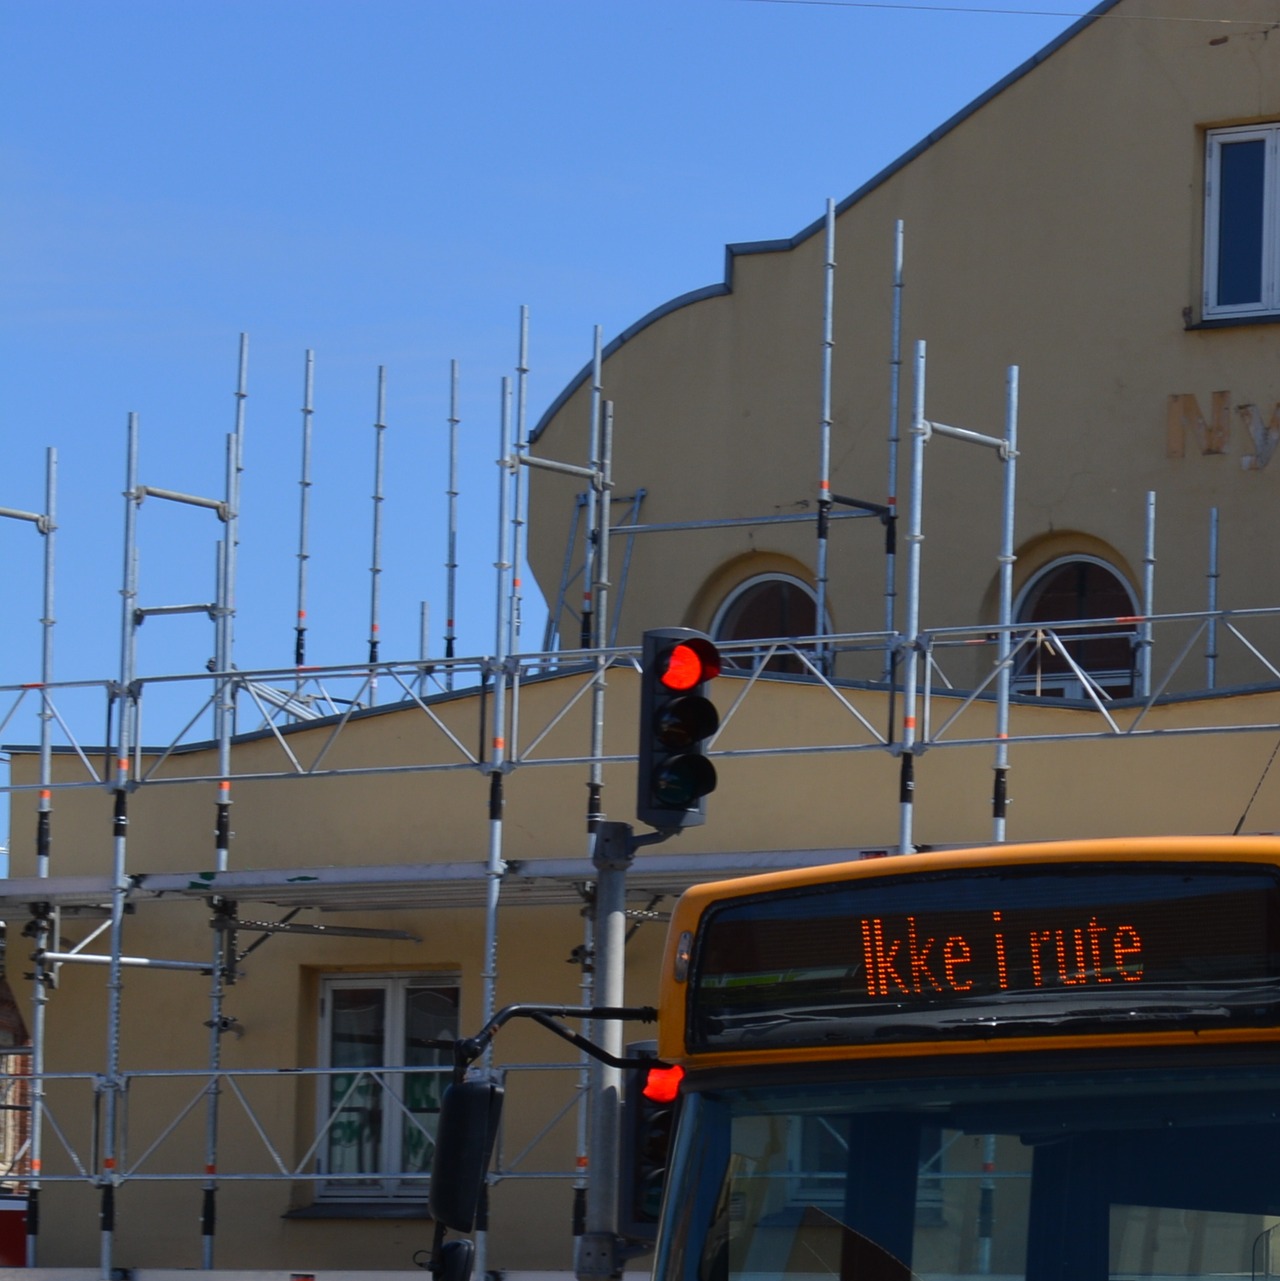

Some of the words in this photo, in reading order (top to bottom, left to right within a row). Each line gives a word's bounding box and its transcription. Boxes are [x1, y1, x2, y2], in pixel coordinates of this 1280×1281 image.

[860, 915, 972, 996] Ikke
[993, 910, 1008, 989] i
[1030, 915, 1144, 987] rute
